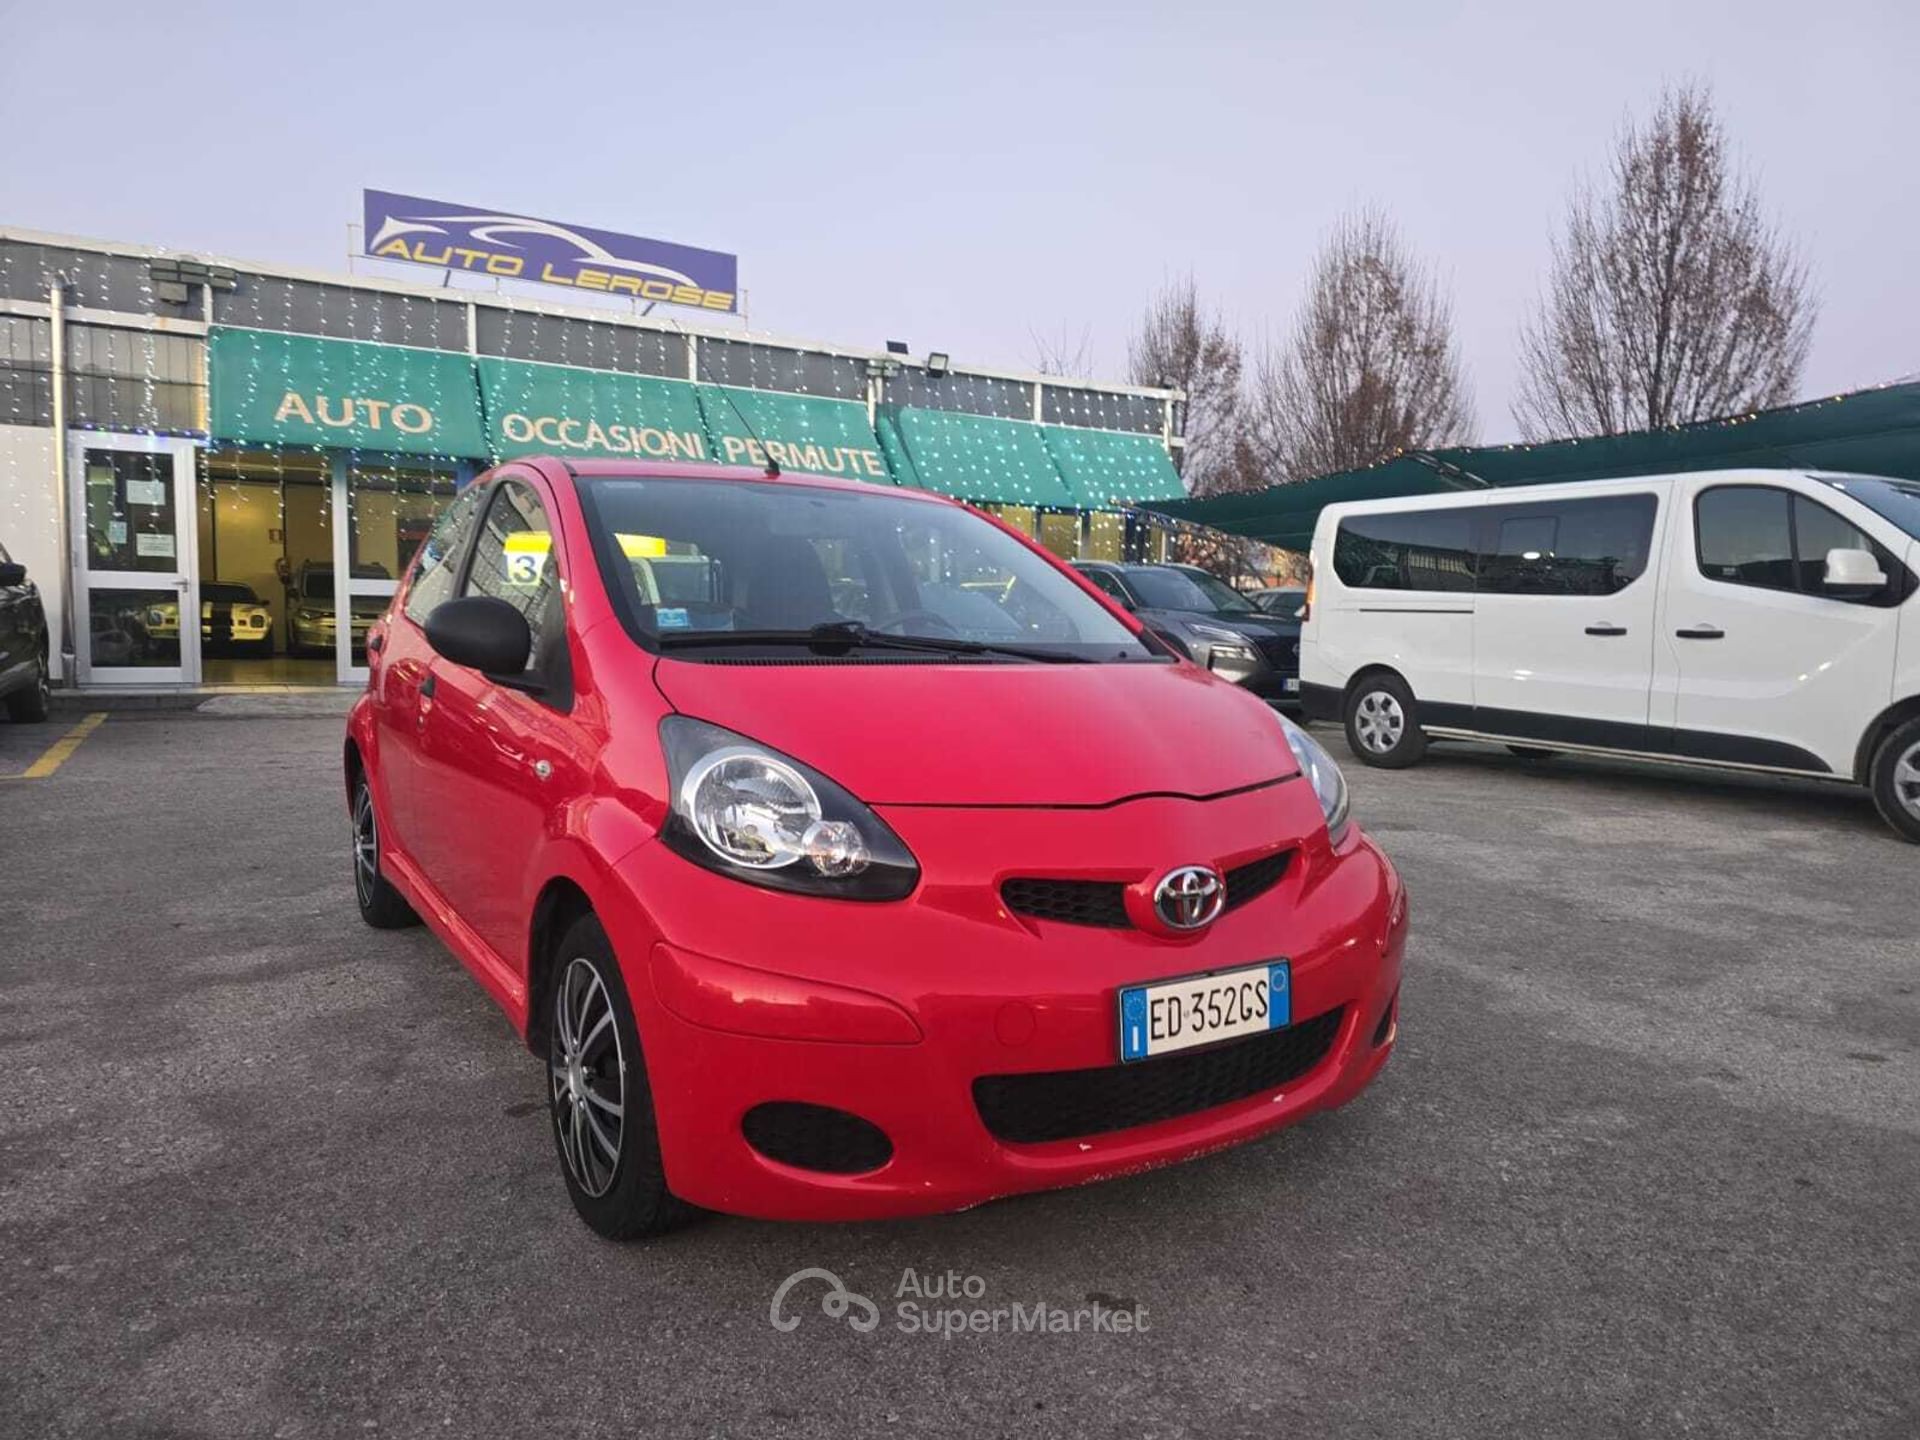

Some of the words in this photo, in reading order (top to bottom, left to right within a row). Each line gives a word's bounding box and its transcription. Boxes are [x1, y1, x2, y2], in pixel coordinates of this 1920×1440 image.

[376, 238, 523, 276] AUTO
[541, 261, 735, 311] LEROSE
[274, 392, 433, 433] AUTO
[502, 413, 706, 459] OCCASIONI
[722, 436, 886, 476] PERMUTE
